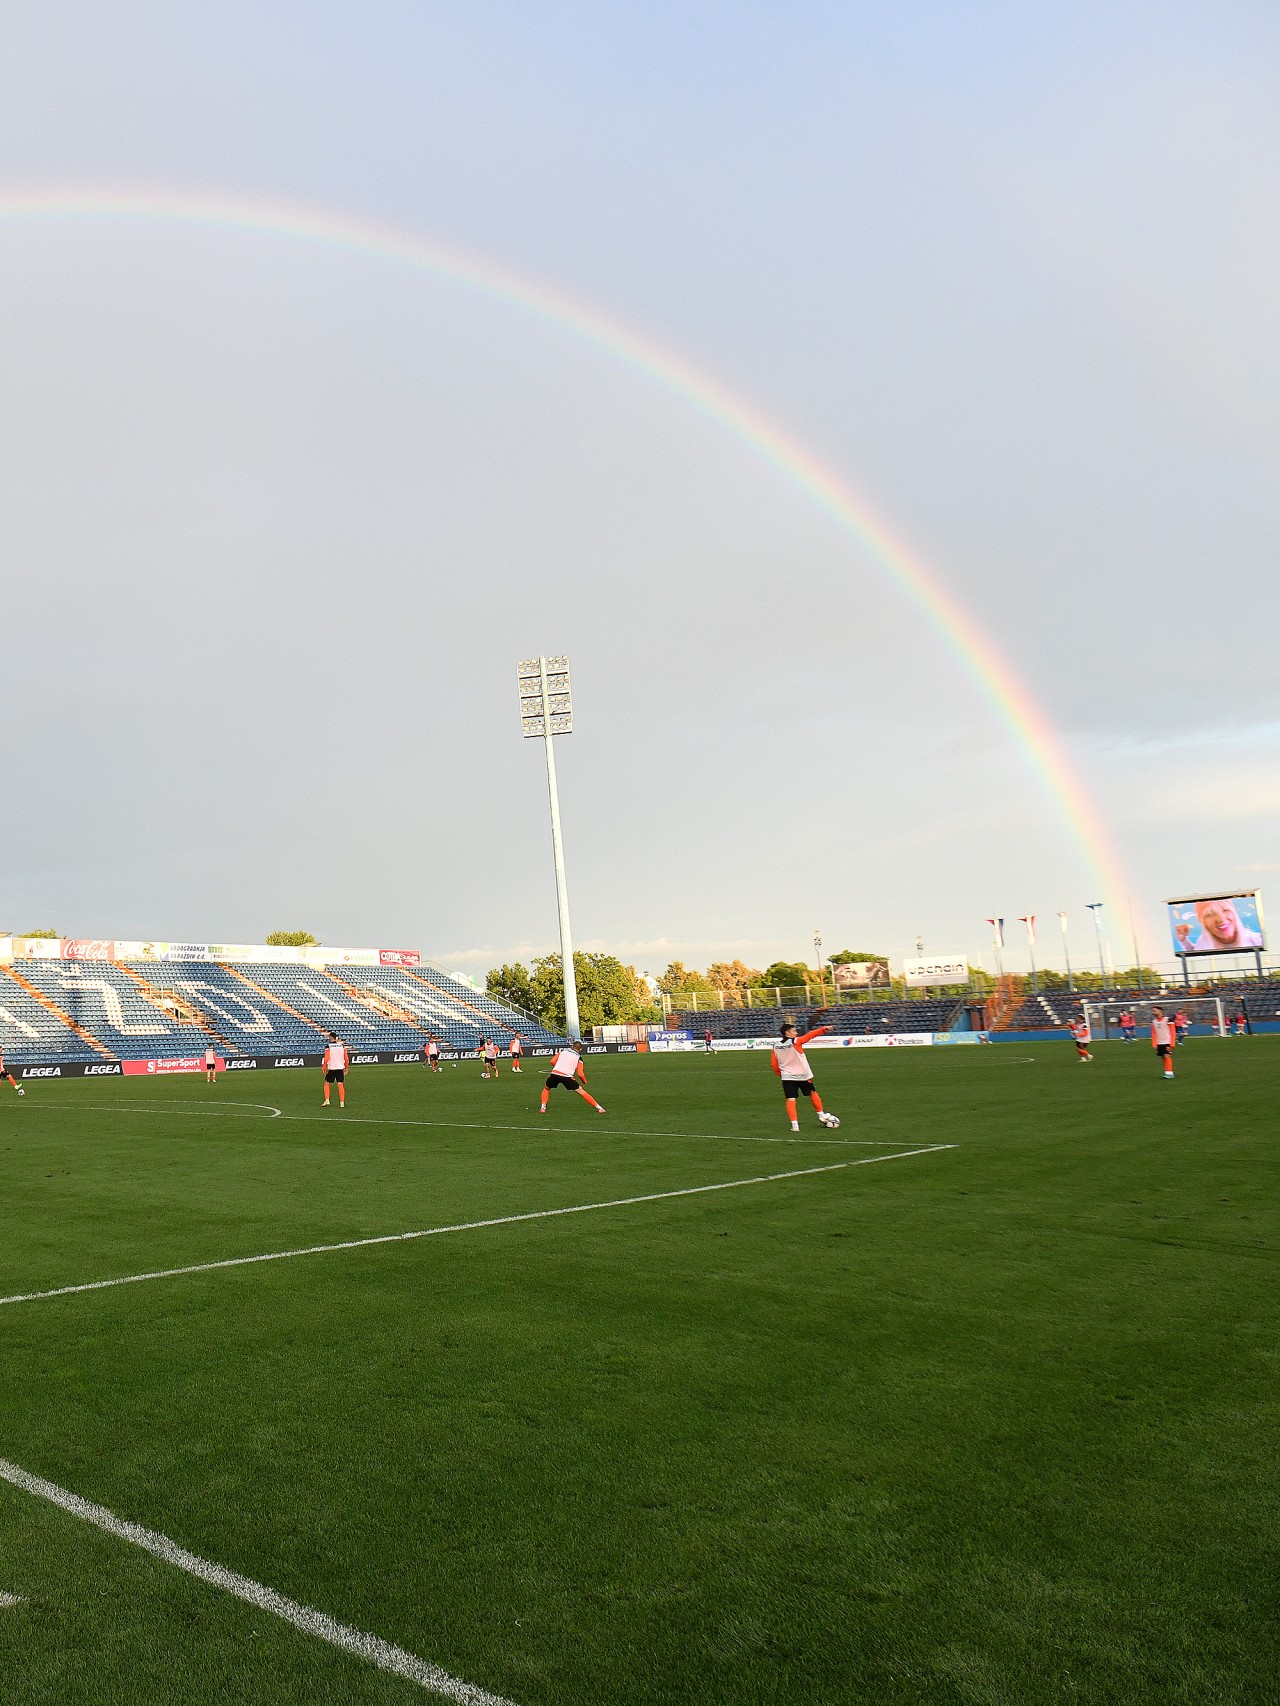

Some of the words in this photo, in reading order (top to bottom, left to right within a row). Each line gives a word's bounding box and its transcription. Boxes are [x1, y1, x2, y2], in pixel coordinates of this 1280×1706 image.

[909, 964, 964, 975] upchain
[618, 1043, 637, 1051] LEGEA
[275, 1058, 304, 1067] LEGEA
[352, 1055, 379, 1063] LEGEA
[394, 1054, 420, 1062] LEGEA
[157, 1059, 200, 1068] SuperSport
[226, 1060, 257, 1069] LEGEA
[22, 1067, 62, 1077] LEGEA
[84, 1065, 121, 1075] LEGEA
